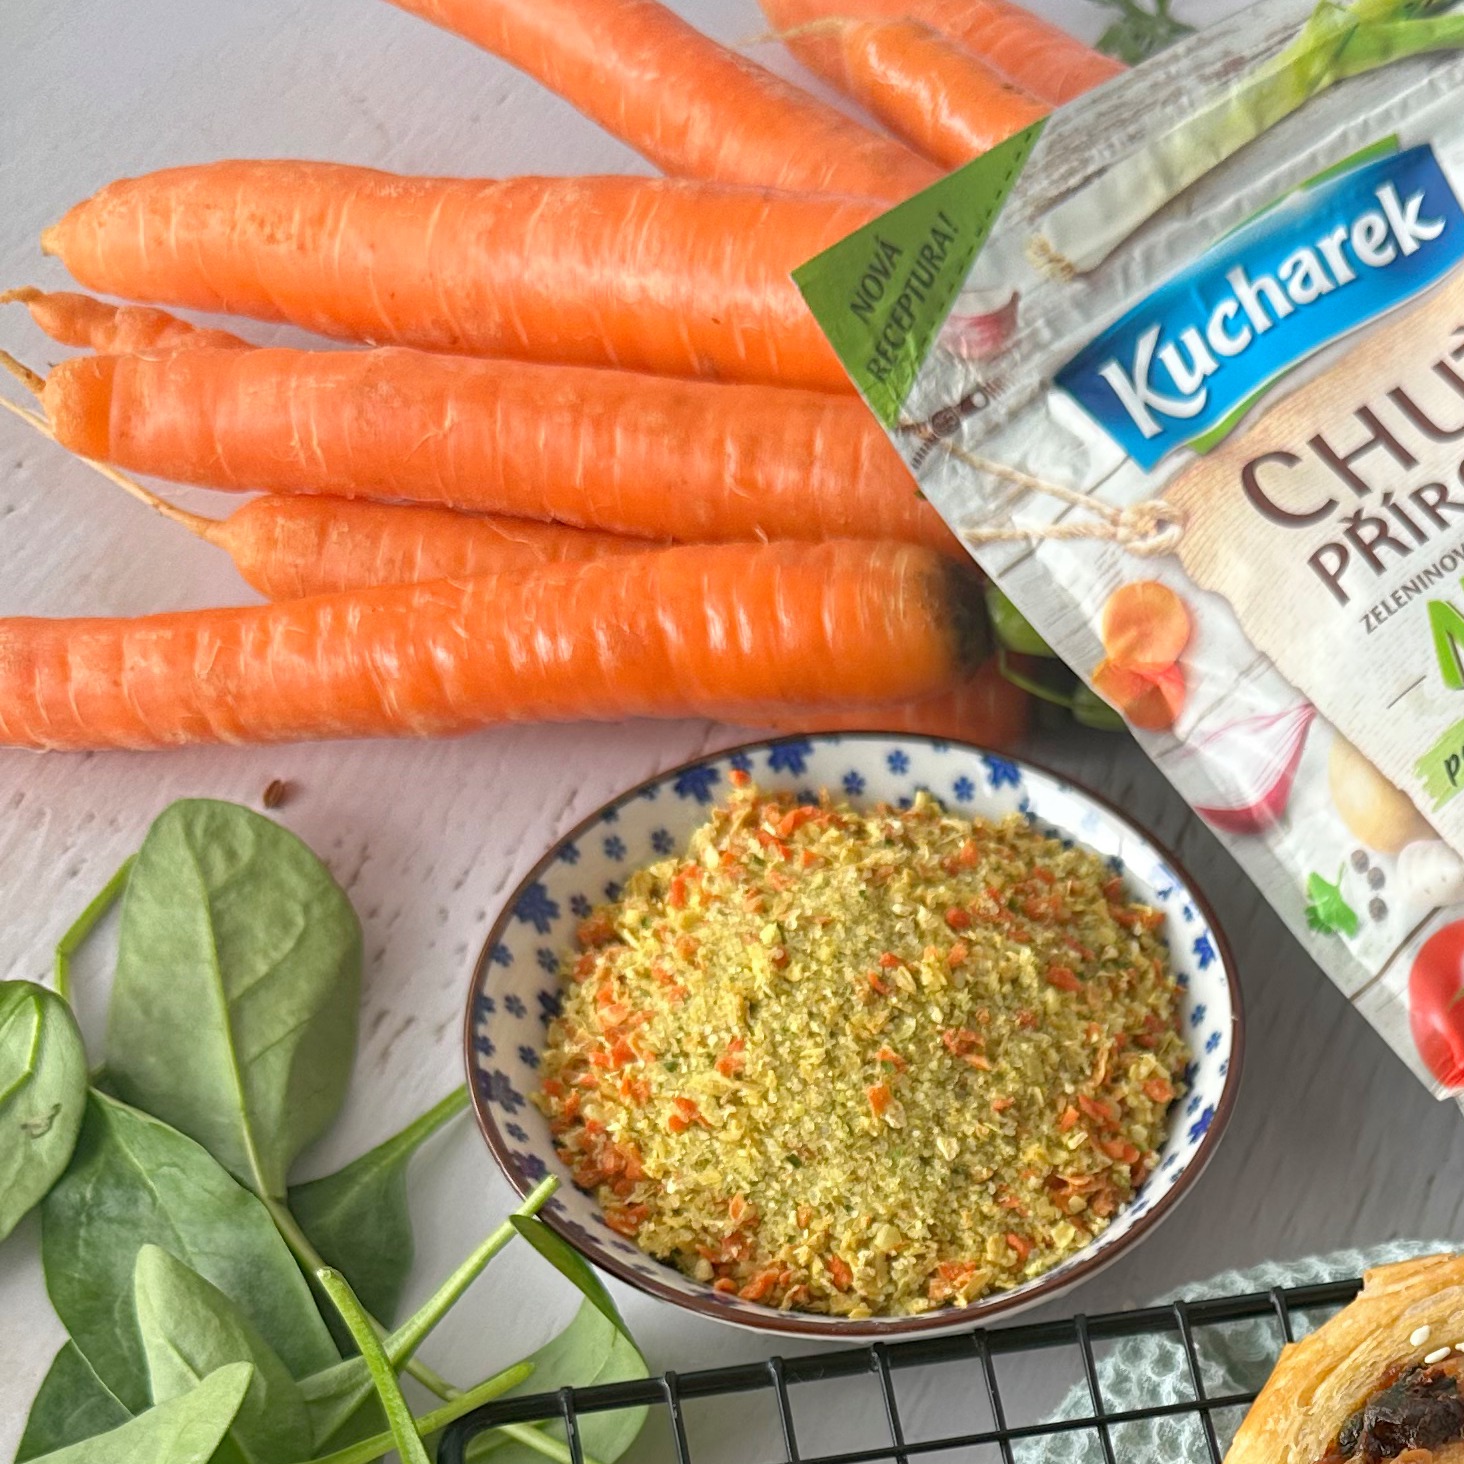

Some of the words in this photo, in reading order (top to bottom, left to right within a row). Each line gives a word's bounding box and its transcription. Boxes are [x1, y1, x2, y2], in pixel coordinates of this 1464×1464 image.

[850, 233, 903, 326] NOVÁ
[866, 211, 959, 384] RECEPTURA!
[1099, 182, 1447, 440] Kucharek
